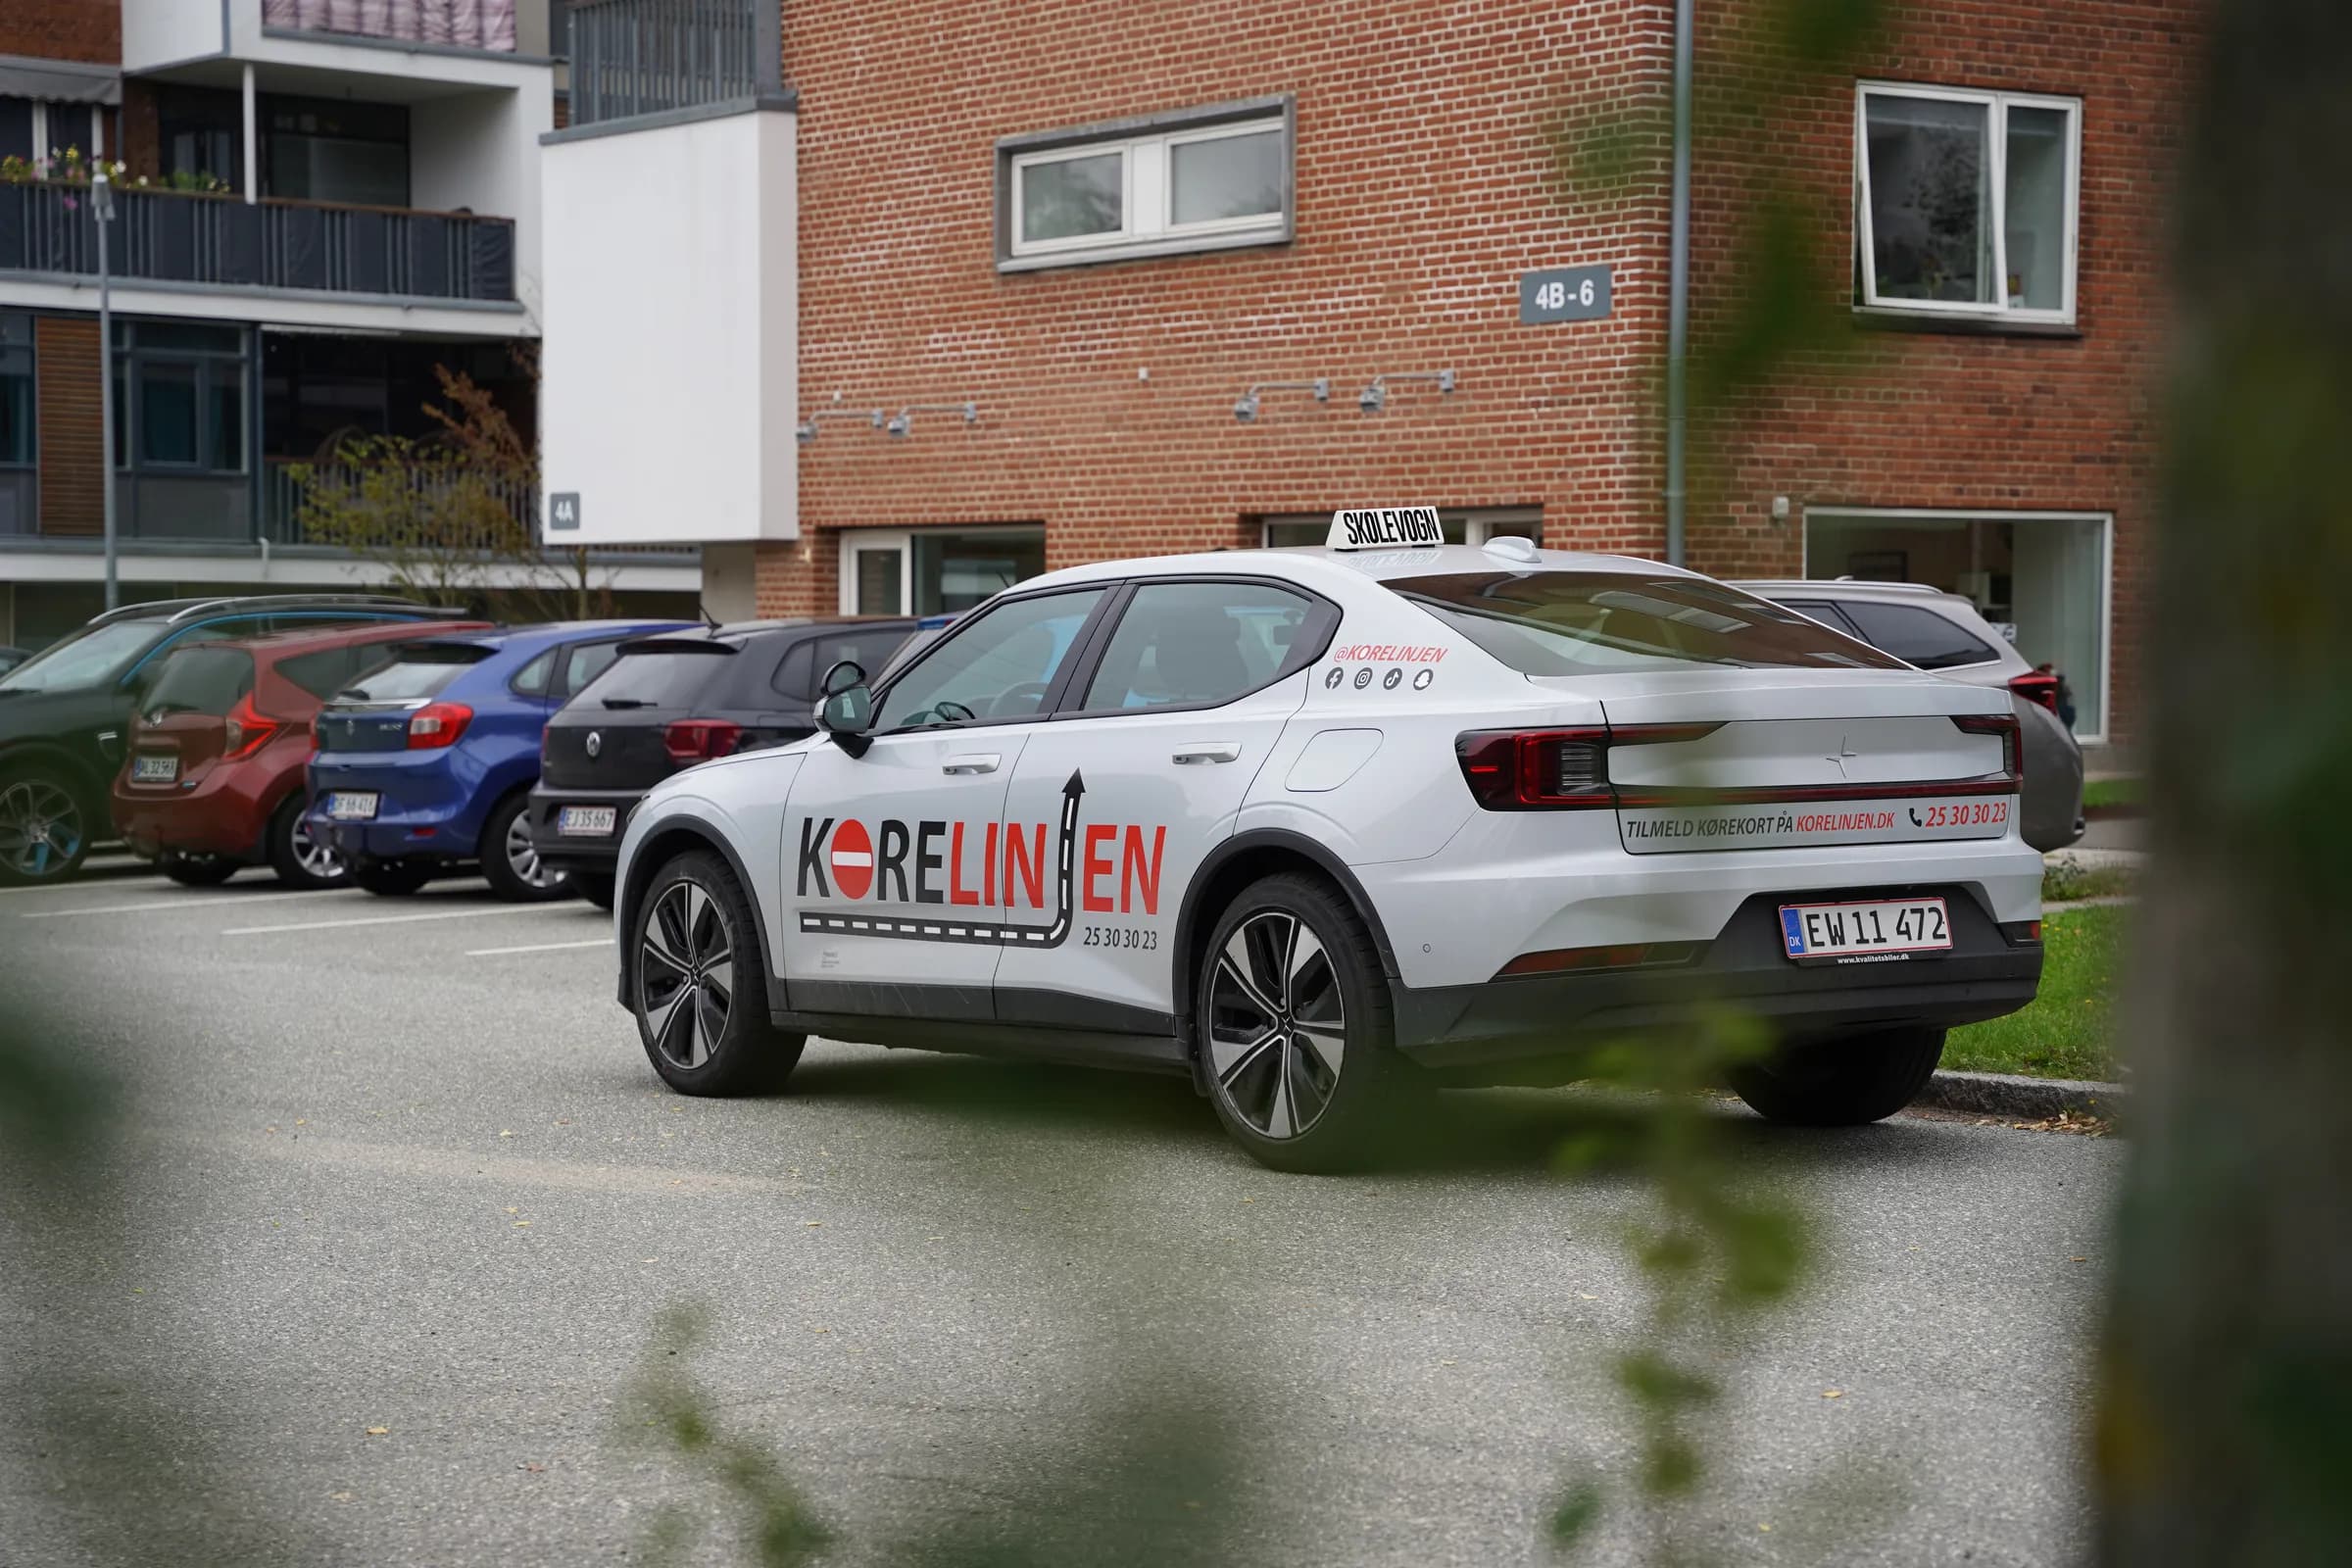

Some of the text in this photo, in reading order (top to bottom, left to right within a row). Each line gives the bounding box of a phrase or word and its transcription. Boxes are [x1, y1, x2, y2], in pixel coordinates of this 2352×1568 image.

[1535, 278, 1594, 311] 4B-6
[555, 499, 574, 521] 4A
[1343, 509, 1440, 545] SKOLEVOGN
[1334, 644, 1448, 663] @KORELINJEN
[1627, 809, 1895, 838] TILMELD KØREKORT PÅ KORELINJEN.DK
[1925, 802, 2007, 828] 25 30 30 23
[1083, 926, 1157, 951] 25 30 30 23
[1805, 906, 1947, 948] EW 11 472
[1788, 936, 1801, 948] DK
[1837, 953, 1910, 965] www.kvalitetsbiler.dk
